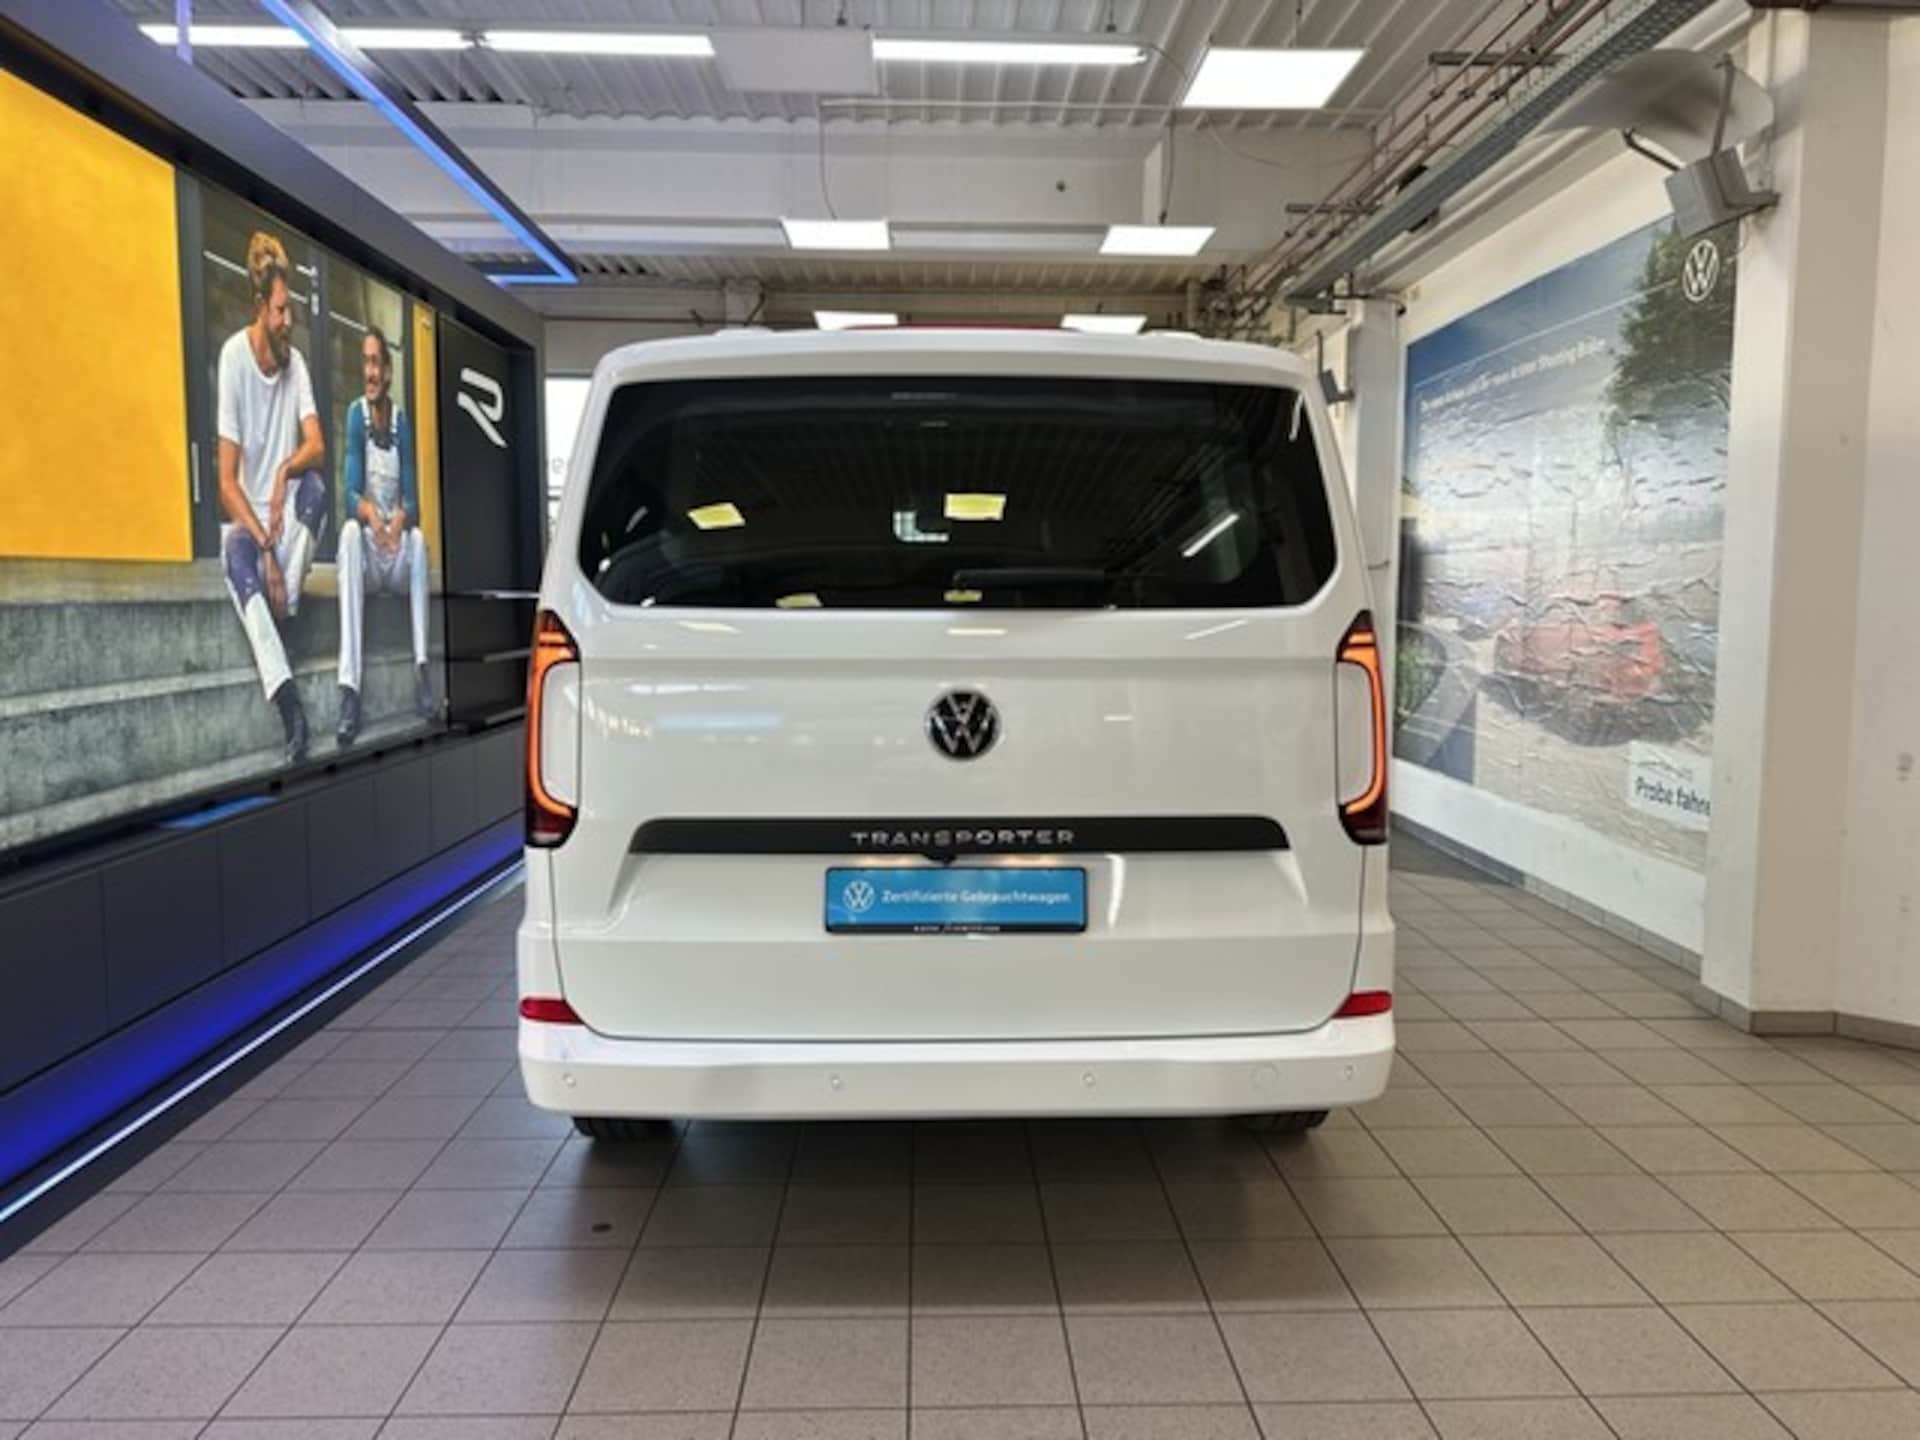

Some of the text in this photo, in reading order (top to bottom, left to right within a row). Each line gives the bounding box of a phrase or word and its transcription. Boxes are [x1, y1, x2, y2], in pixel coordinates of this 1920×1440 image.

[1635, 776, 1674, 805] Probe
[851, 829, 1075, 846] TRANSPORTER
[881, 889, 957, 904] Zertifizierte
[960, 888, 1071, 905] Gebrauchtwagen
